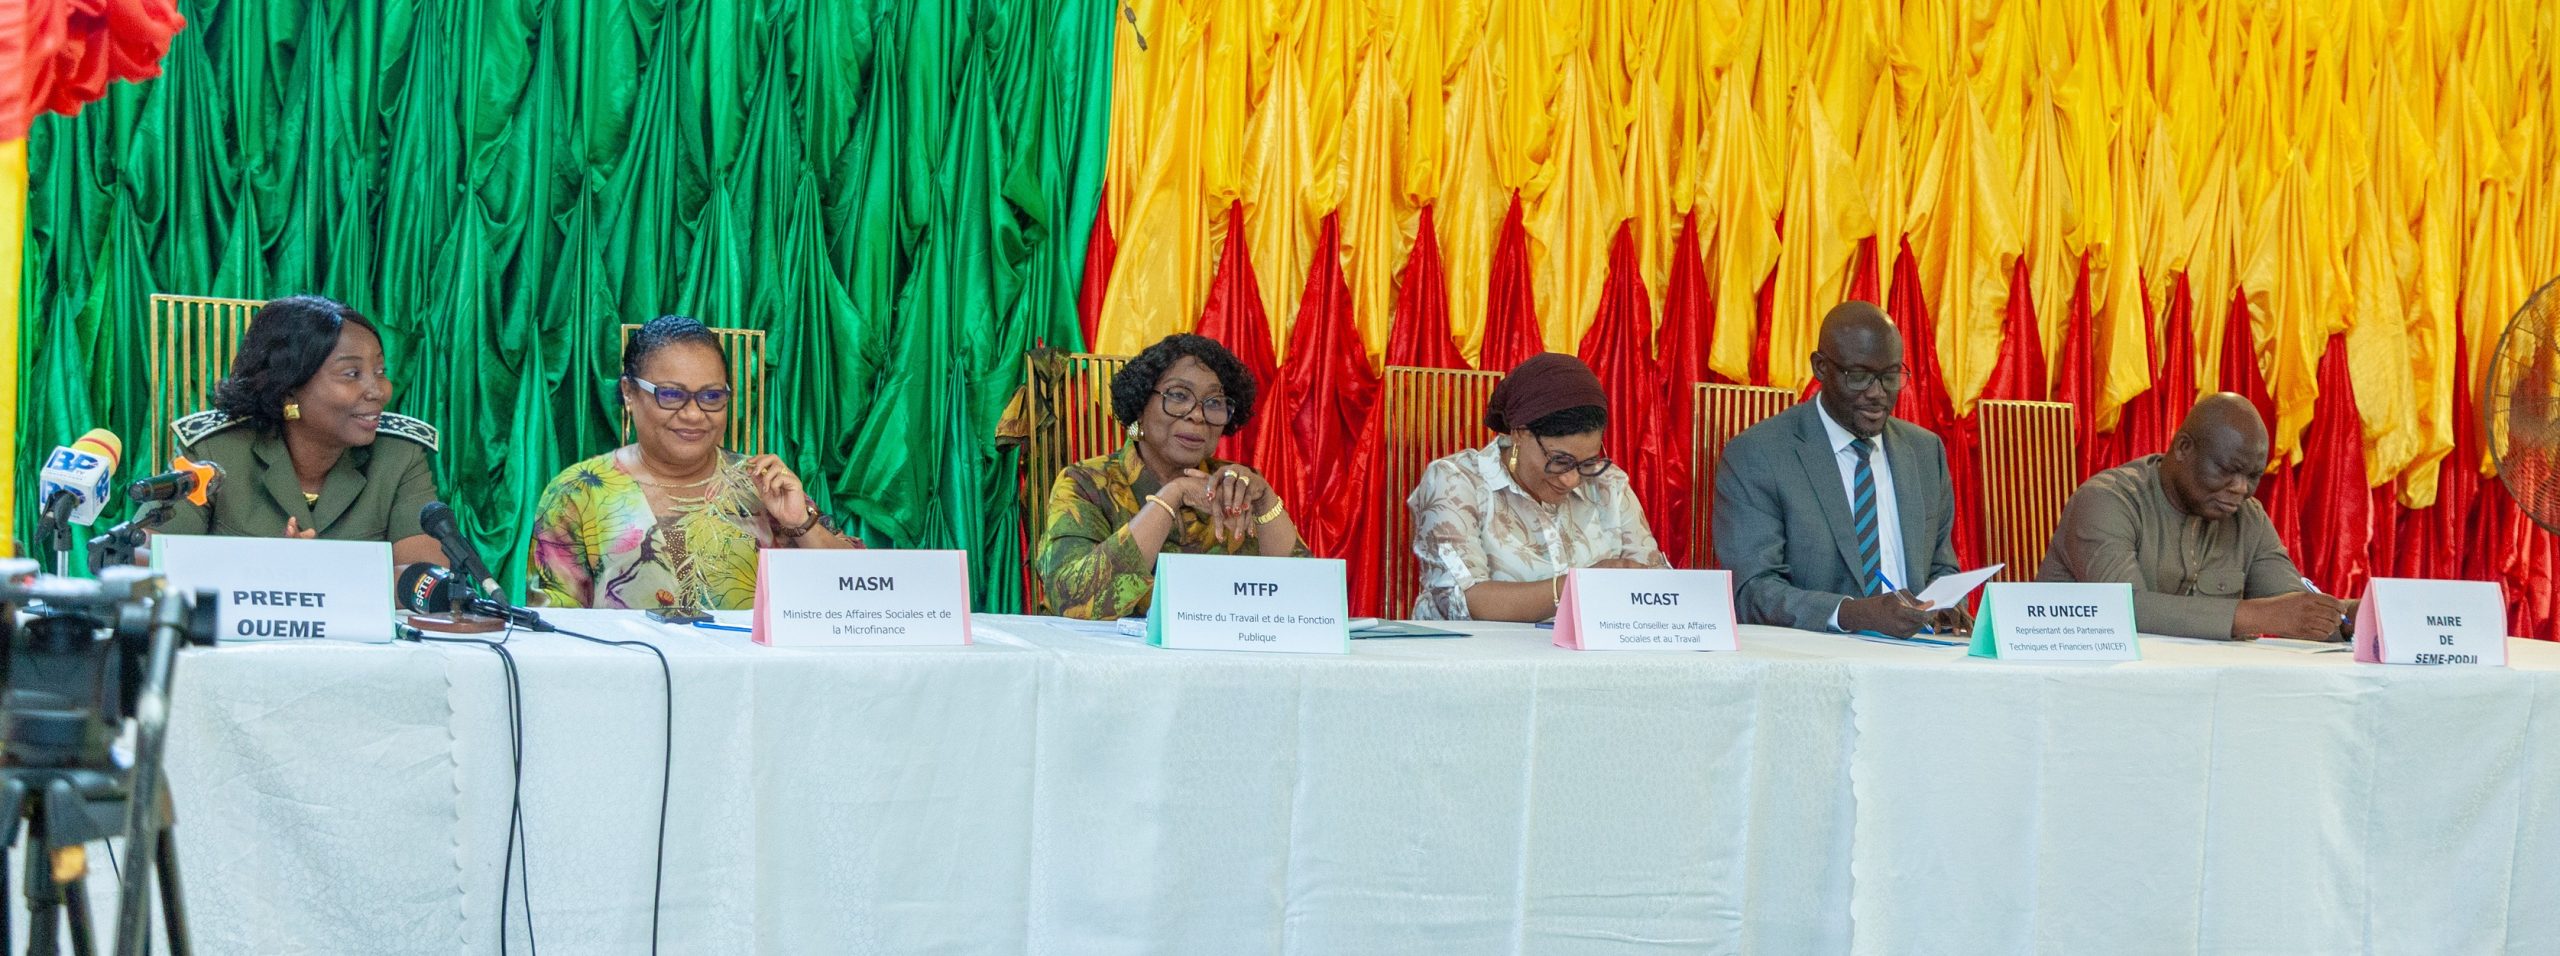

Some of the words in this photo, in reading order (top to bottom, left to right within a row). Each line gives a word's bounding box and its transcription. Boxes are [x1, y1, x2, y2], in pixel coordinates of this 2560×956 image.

[838, 576, 894, 591] MASM
[416, 576, 434, 607] SRTB
[1234, 582, 1279, 597] MTFP
[233, 590, 326, 608] PREFET
[1631, 592, 1679, 606] MCAST
[783, 609, 822, 619] Ministre
[825, 609, 842, 619] des
[845, 609, 882, 619] Affaires
[885, 609, 924, 619] Sociales
[926, 610, 937, 619] et
[940, 609, 952, 619] de
[2027, 605, 2047, 617] RR
[2049, 605, 2099, 618] UNICEF
[1177, 611, 1213, 622] Ministre
[1215, 612, 1227, 622] du
[1229, 613, 1259, 623] Travail
[1262, 614, 1271, 623] et
[1274, 614, 1285, 624] de
[1288, 614, 1296, 624] la
[1298, 615, 1335, 625] Fonction
[2426, 616, 2462, 626] MAIRE
[237, 618, 326, 638] OUEME
[833, 625, 841, 634] la
[844, 625, 906, 635] Microfinance
[1600, 621, 1631, 630] Ministre
[1633, 621, 1669, 630] Conseiller
[1671, 622, 1685, 630] aux
[1688, 622, 1717, 630] Affaires
[2016, 626, 2061, 636] Représentant
[2063, 626, 2075, 635] des
[2077, 626, 2115, 635] Partenaires
[1238, 632, 1277, 644] Publique
[1620, 634, 1651, 644] Sociales
[1653, 636, 1661, 644] et
[1663, 636, 1673, 644] au
[1675, 634, 1701, 644] Travail
[2439, 635, 2454, 646] DE
[2009, 642, 2049, 653] Techniques
[2051, 643, 2058, 652] et
[2059, 642, 2094, 652] Financiers
[2095, 642, 2127, 653] (UNICEF)
[2415, 654, 2478, 664] SEME-PODJI
